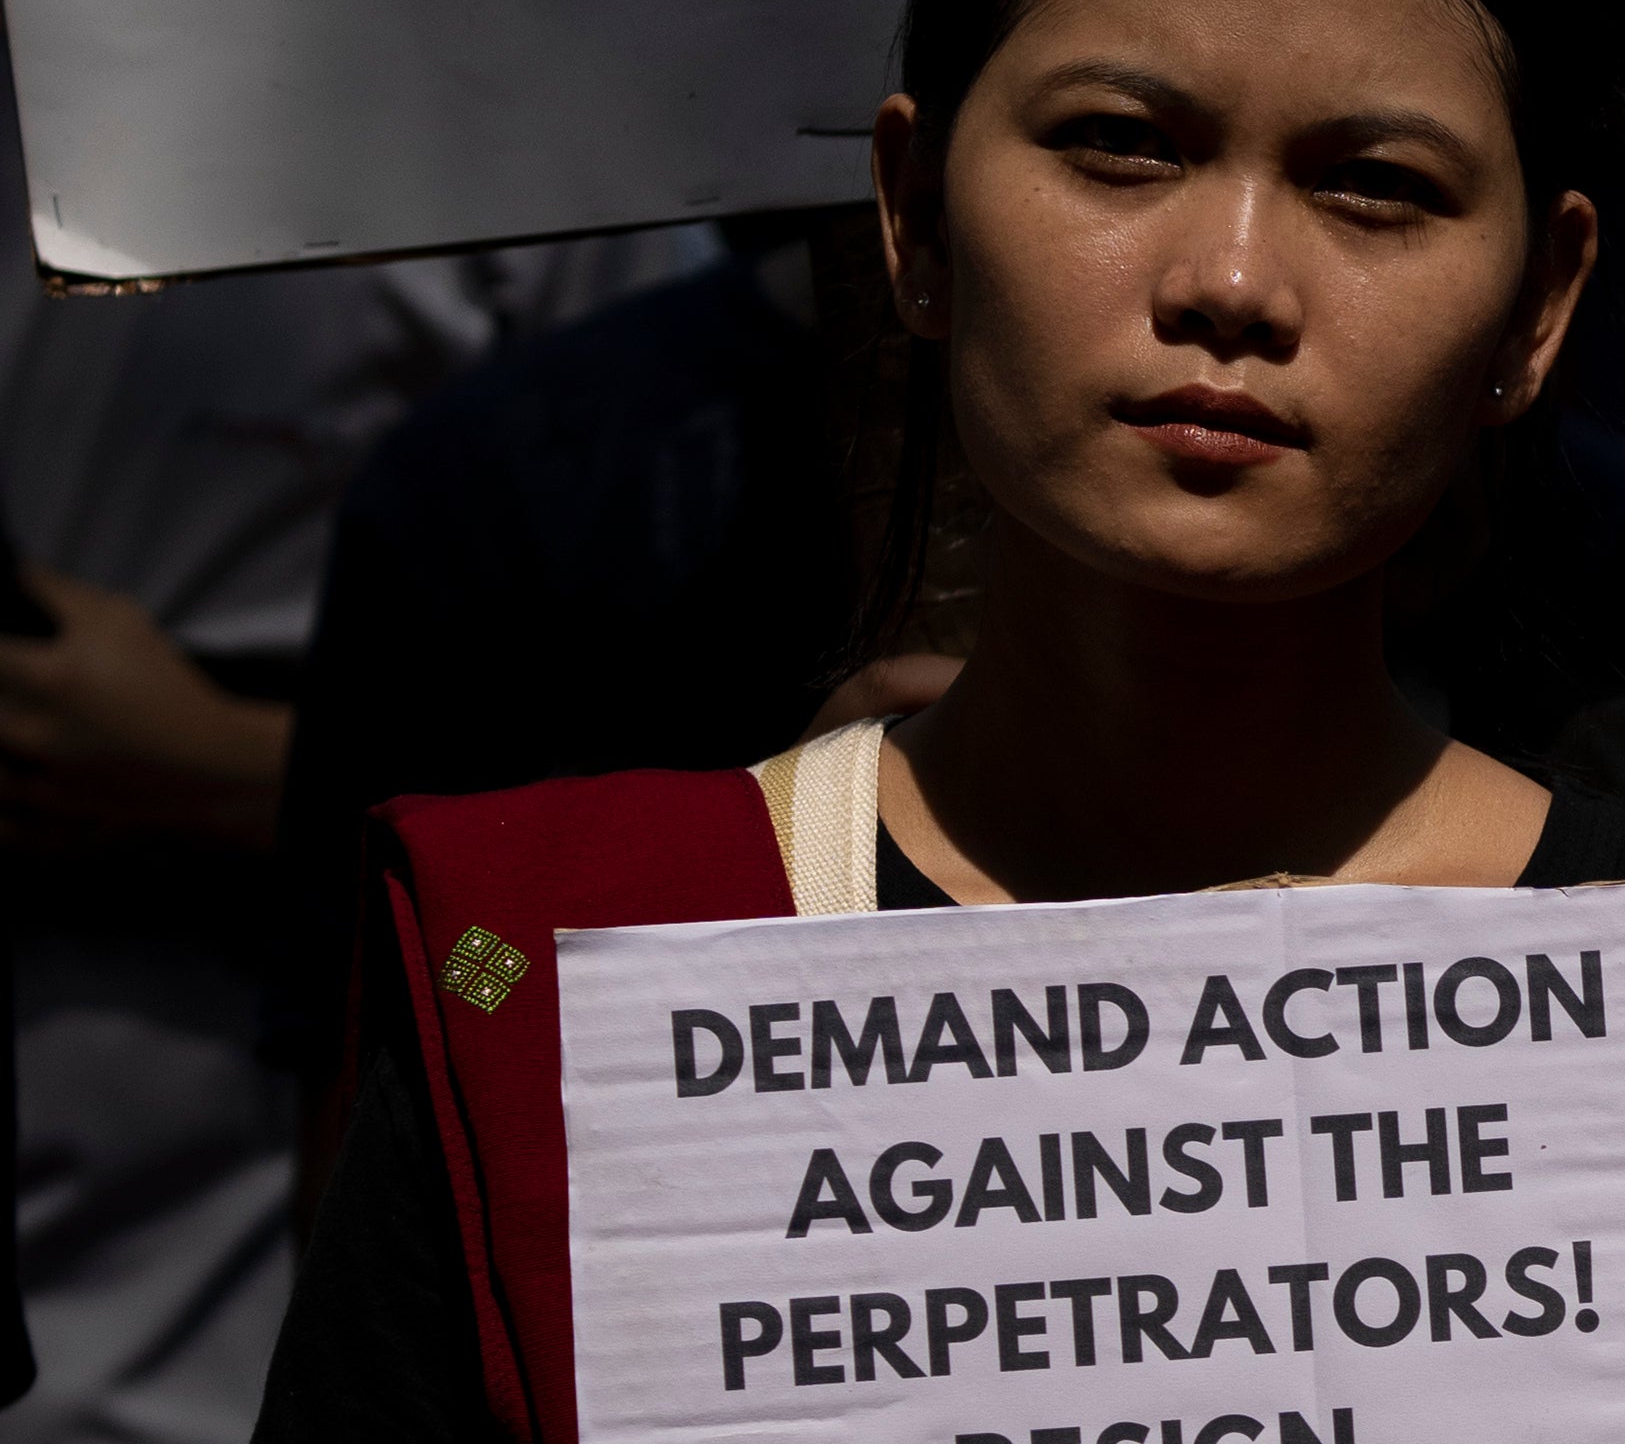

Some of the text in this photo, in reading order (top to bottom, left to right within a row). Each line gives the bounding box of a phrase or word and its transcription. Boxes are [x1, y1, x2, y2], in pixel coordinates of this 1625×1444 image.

[672, 950, 1606, 1098] DEMAND ACTION
[786, 1104, 1513, 1238] AGAINST THE
[720, 1239, 1599, 1391] PERPETRATORS!
